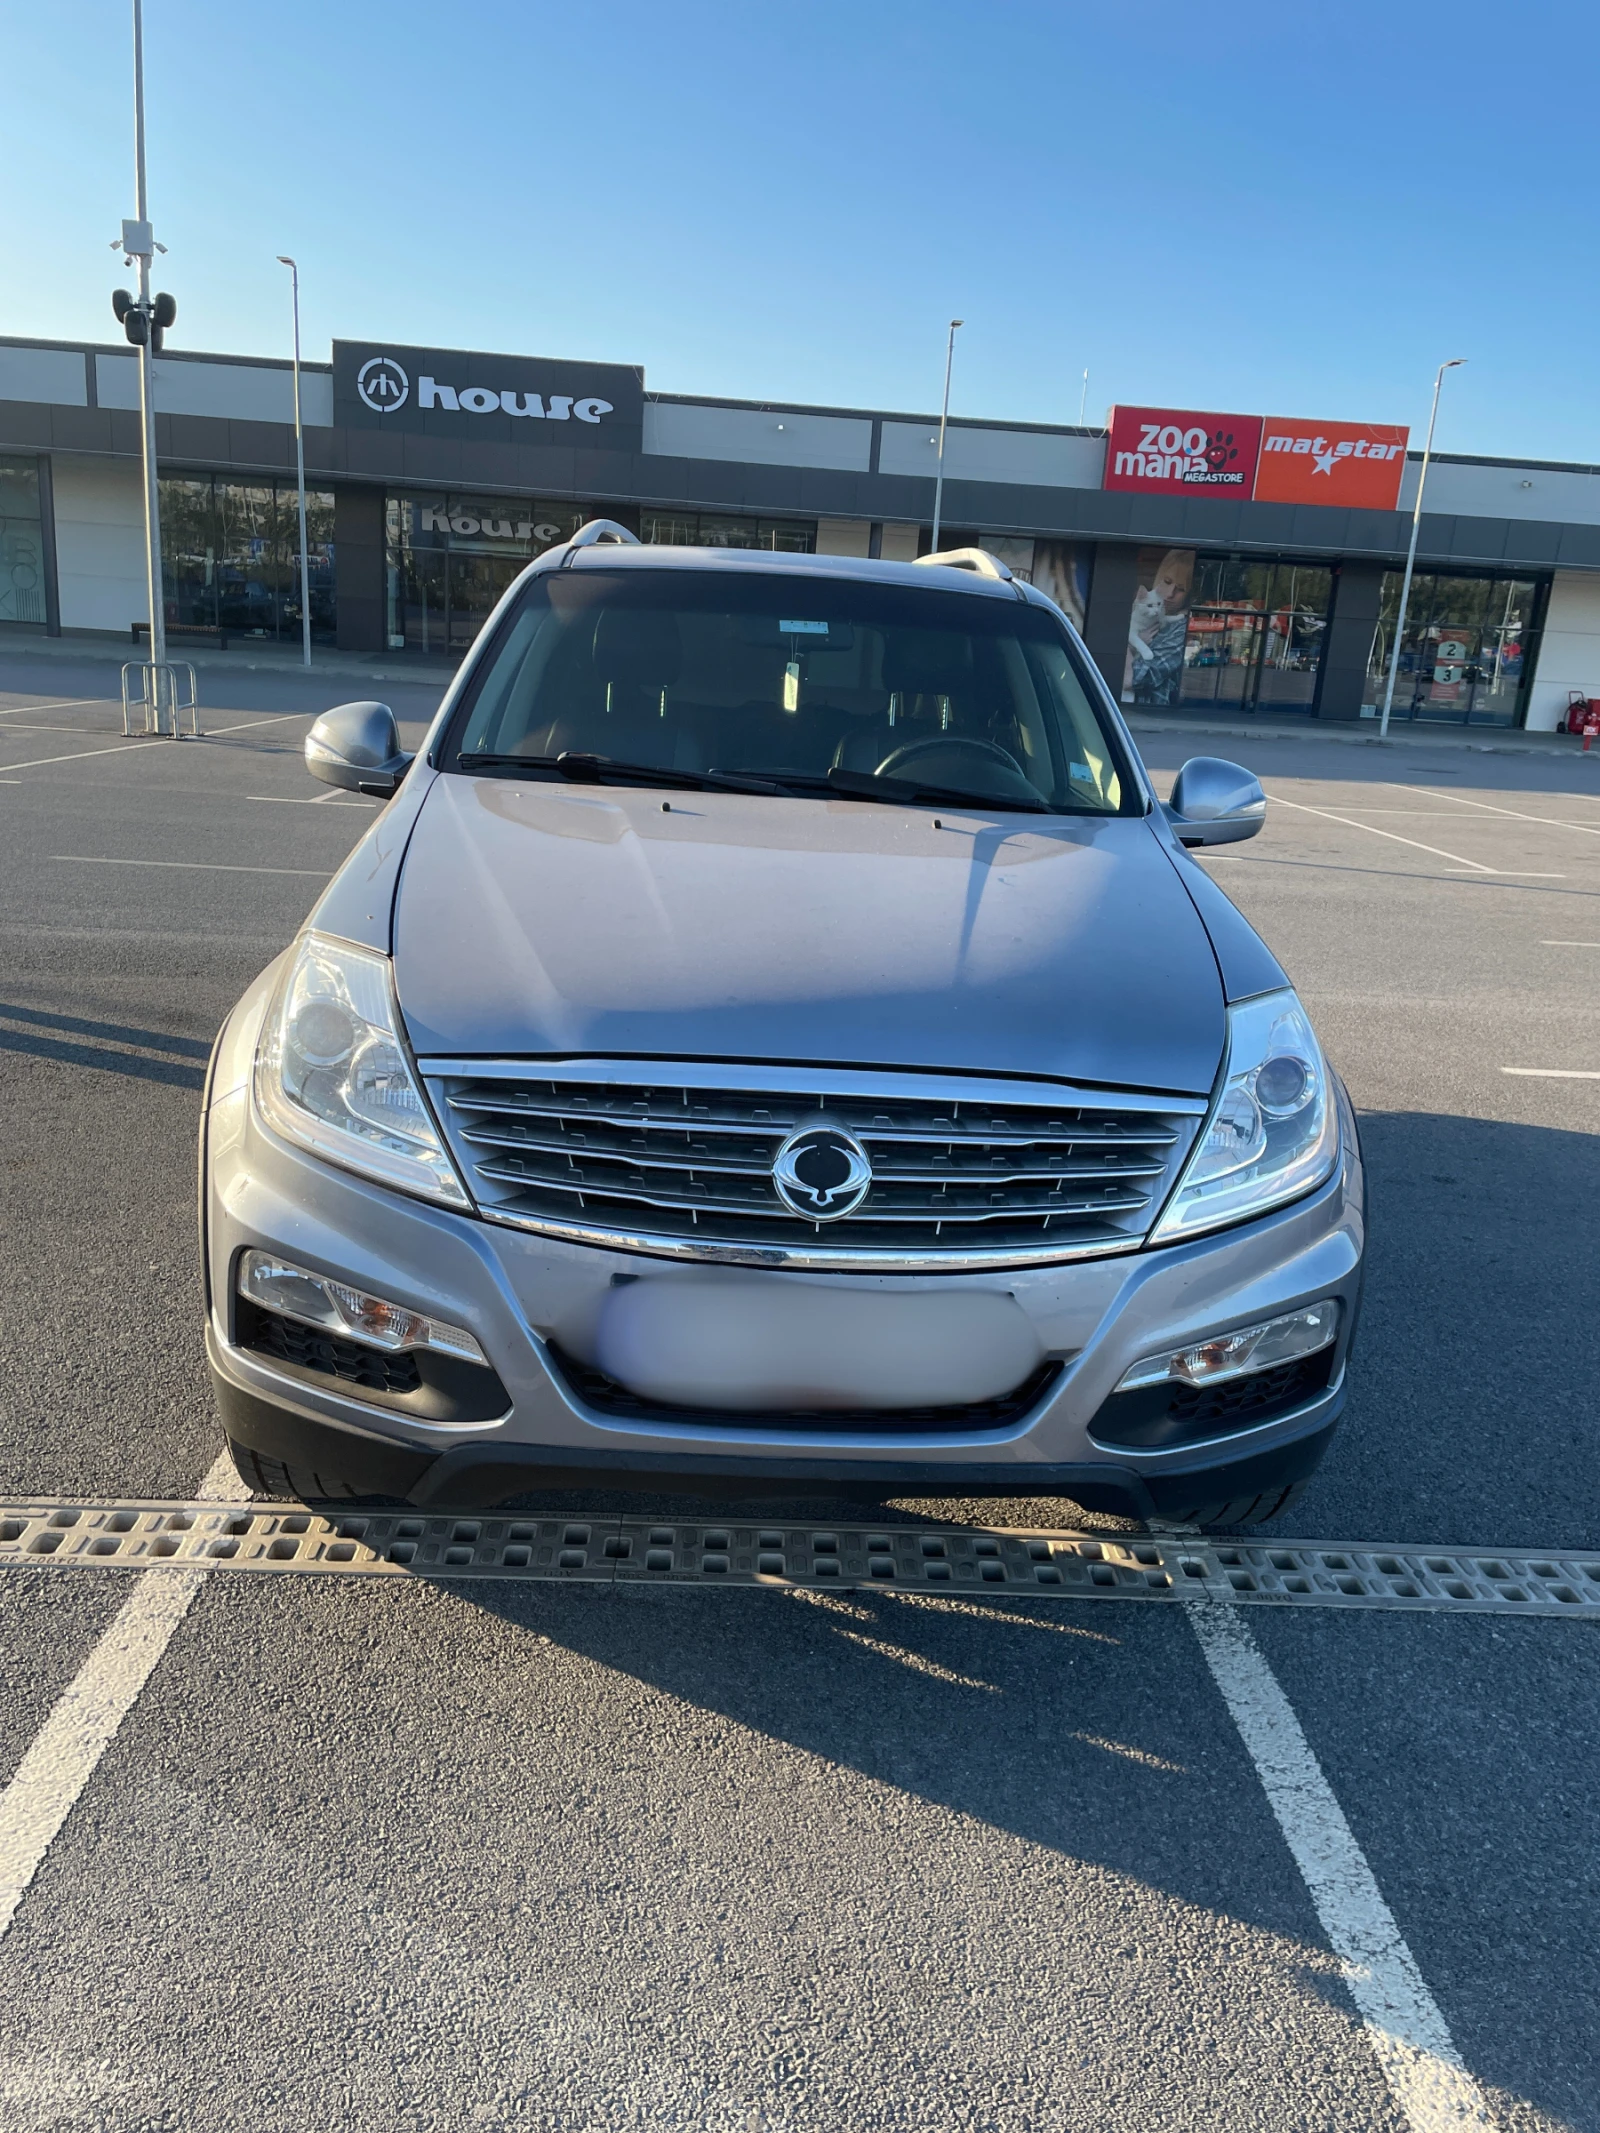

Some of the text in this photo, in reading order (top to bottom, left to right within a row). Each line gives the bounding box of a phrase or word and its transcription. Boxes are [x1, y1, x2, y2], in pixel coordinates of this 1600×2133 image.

[418, 375, 614, 424] house
[1264, 435, 1403, 461] mat star
[1114, 451, 1209, 480] mania
[1183, 472, 1244, 483] MEGASTORE
[421, 508, 561, 542] house
[1446, 643, 1457, 657] 2
[1442, 669, 1452, 682] 3
